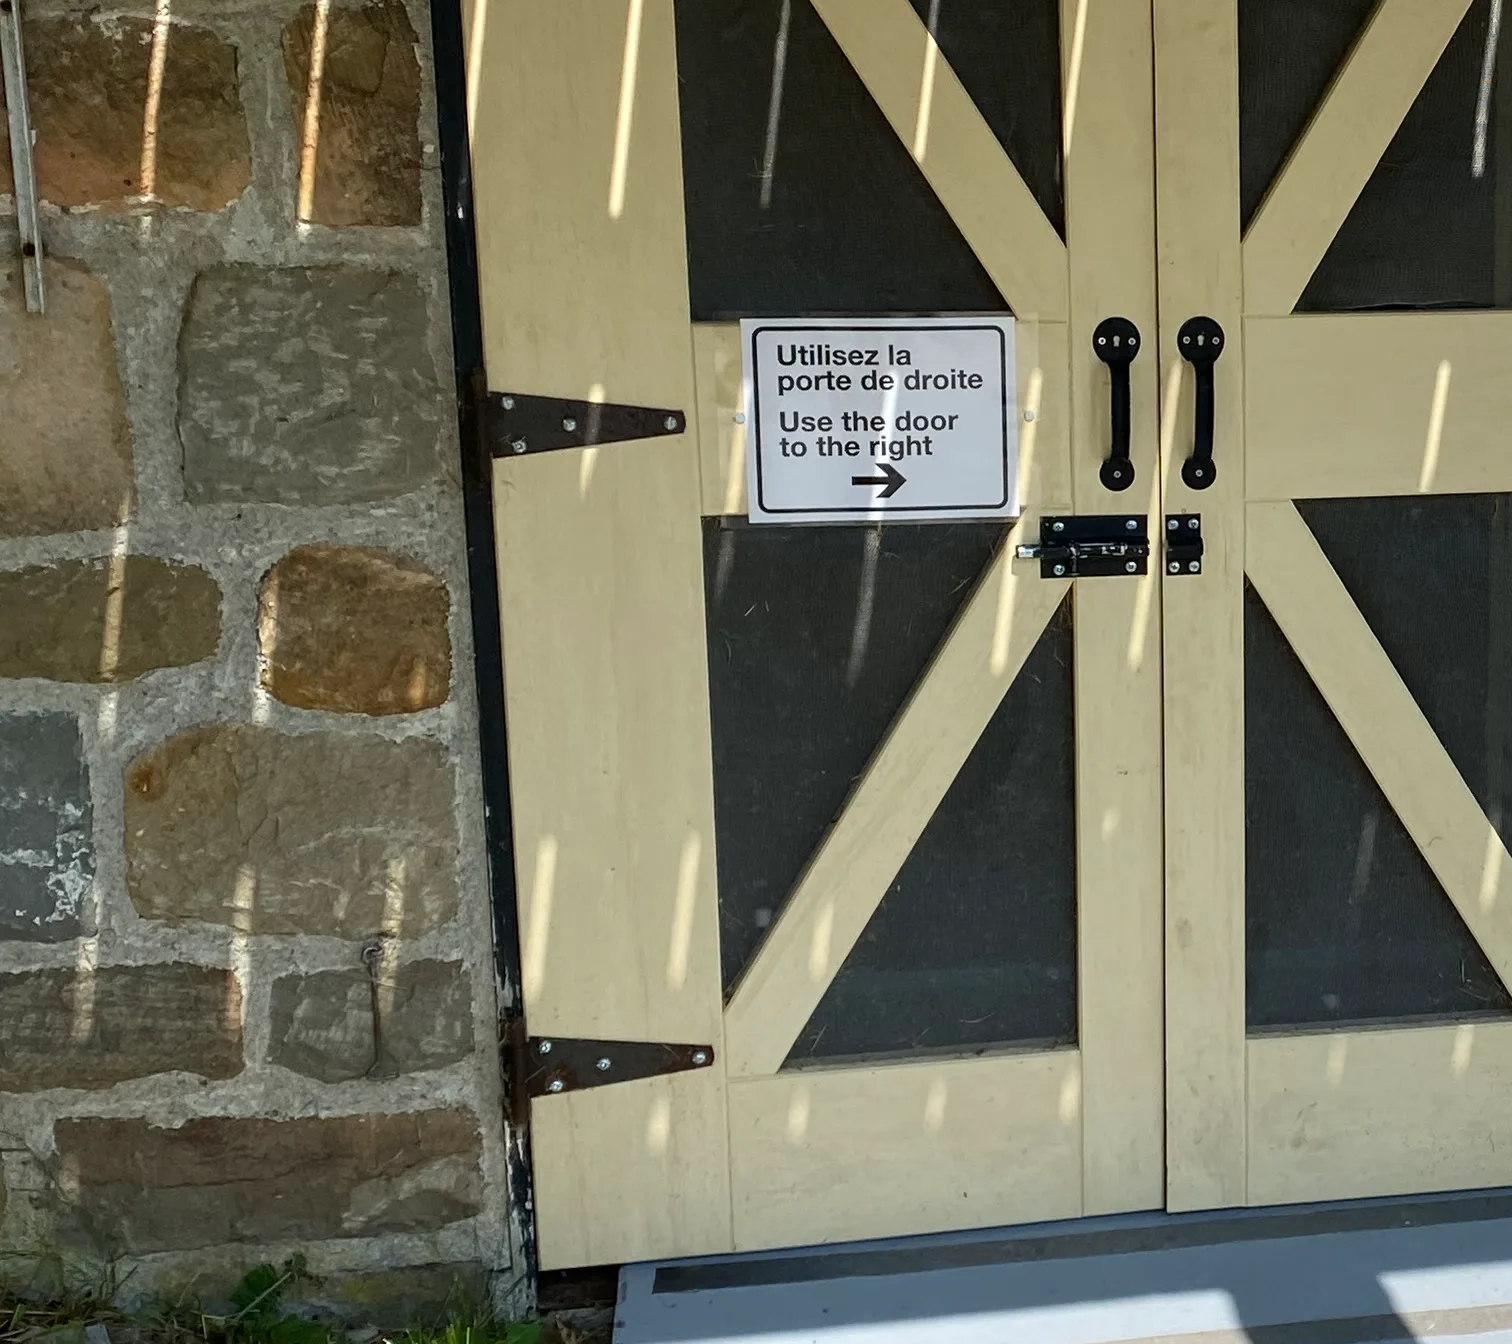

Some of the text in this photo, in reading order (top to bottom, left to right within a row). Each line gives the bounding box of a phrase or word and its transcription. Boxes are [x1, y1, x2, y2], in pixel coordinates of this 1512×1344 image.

[777, 344, 912, 366] Utilisez la
[778, 369, 984, 396] porte de droite
[779, 410, 959, 432] Use the door
[779, 435, 933, 461] to the right
